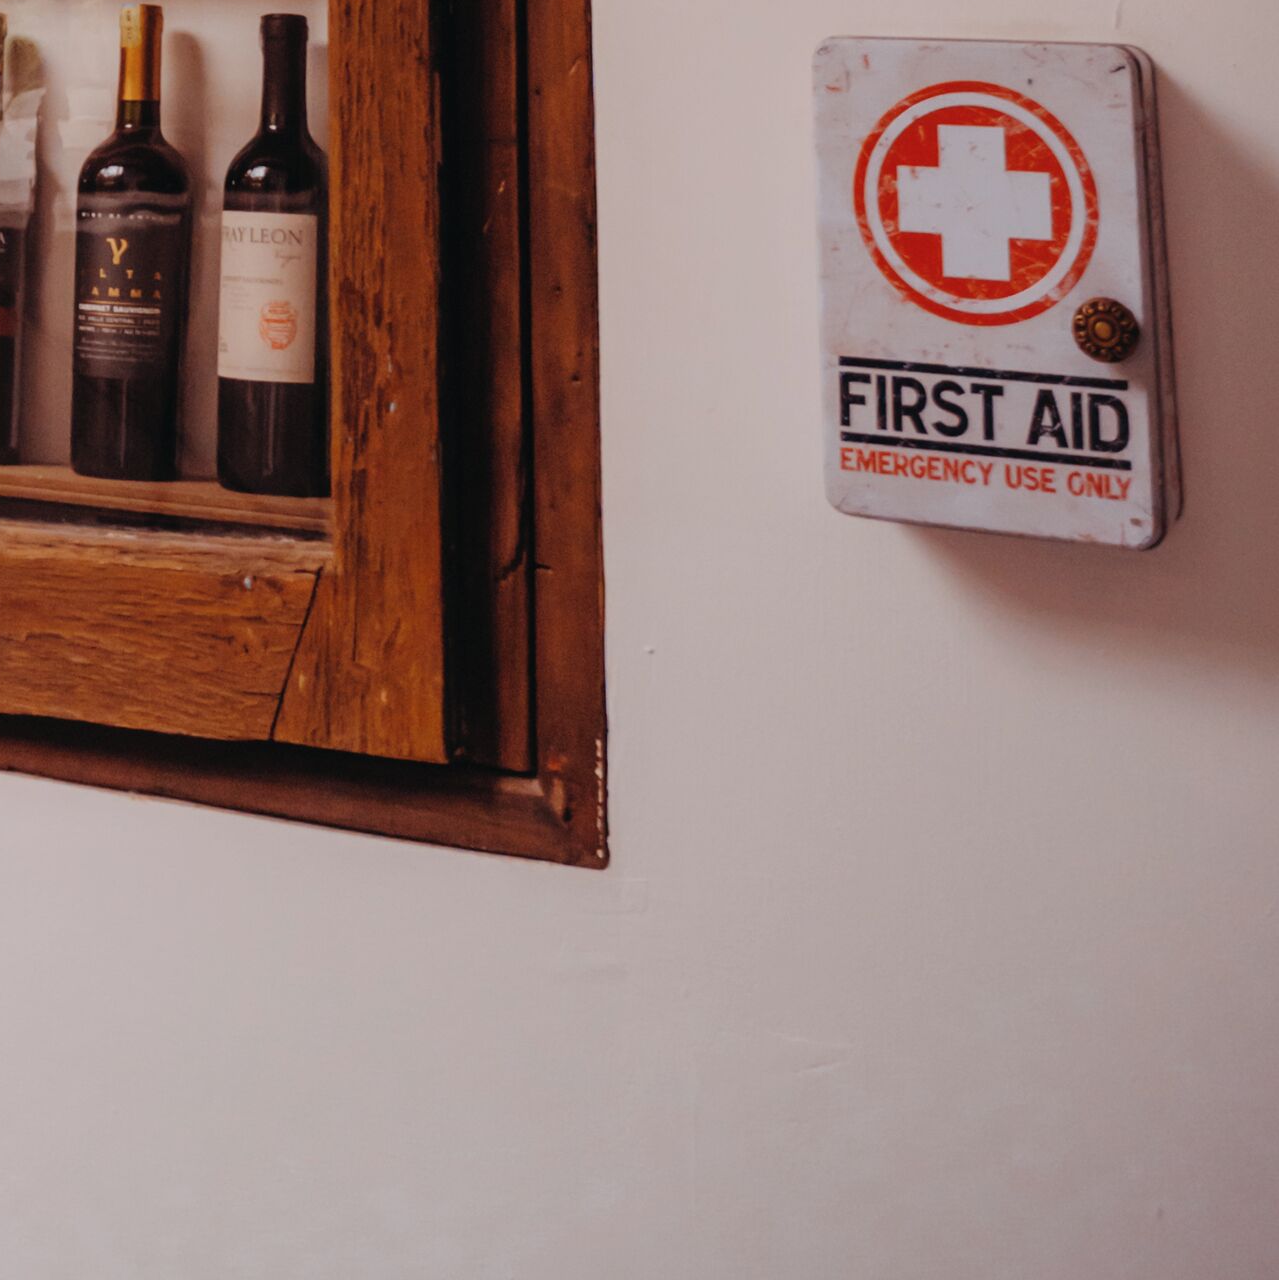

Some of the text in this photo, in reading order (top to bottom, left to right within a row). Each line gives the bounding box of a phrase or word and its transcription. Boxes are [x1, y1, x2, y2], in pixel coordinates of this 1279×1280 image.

[250, 227, 304, 245] LEON
[839, 371, 1130, 453] FIRST AID
[840, 446, 1132, 502] EMERGENCY USE ONLY
